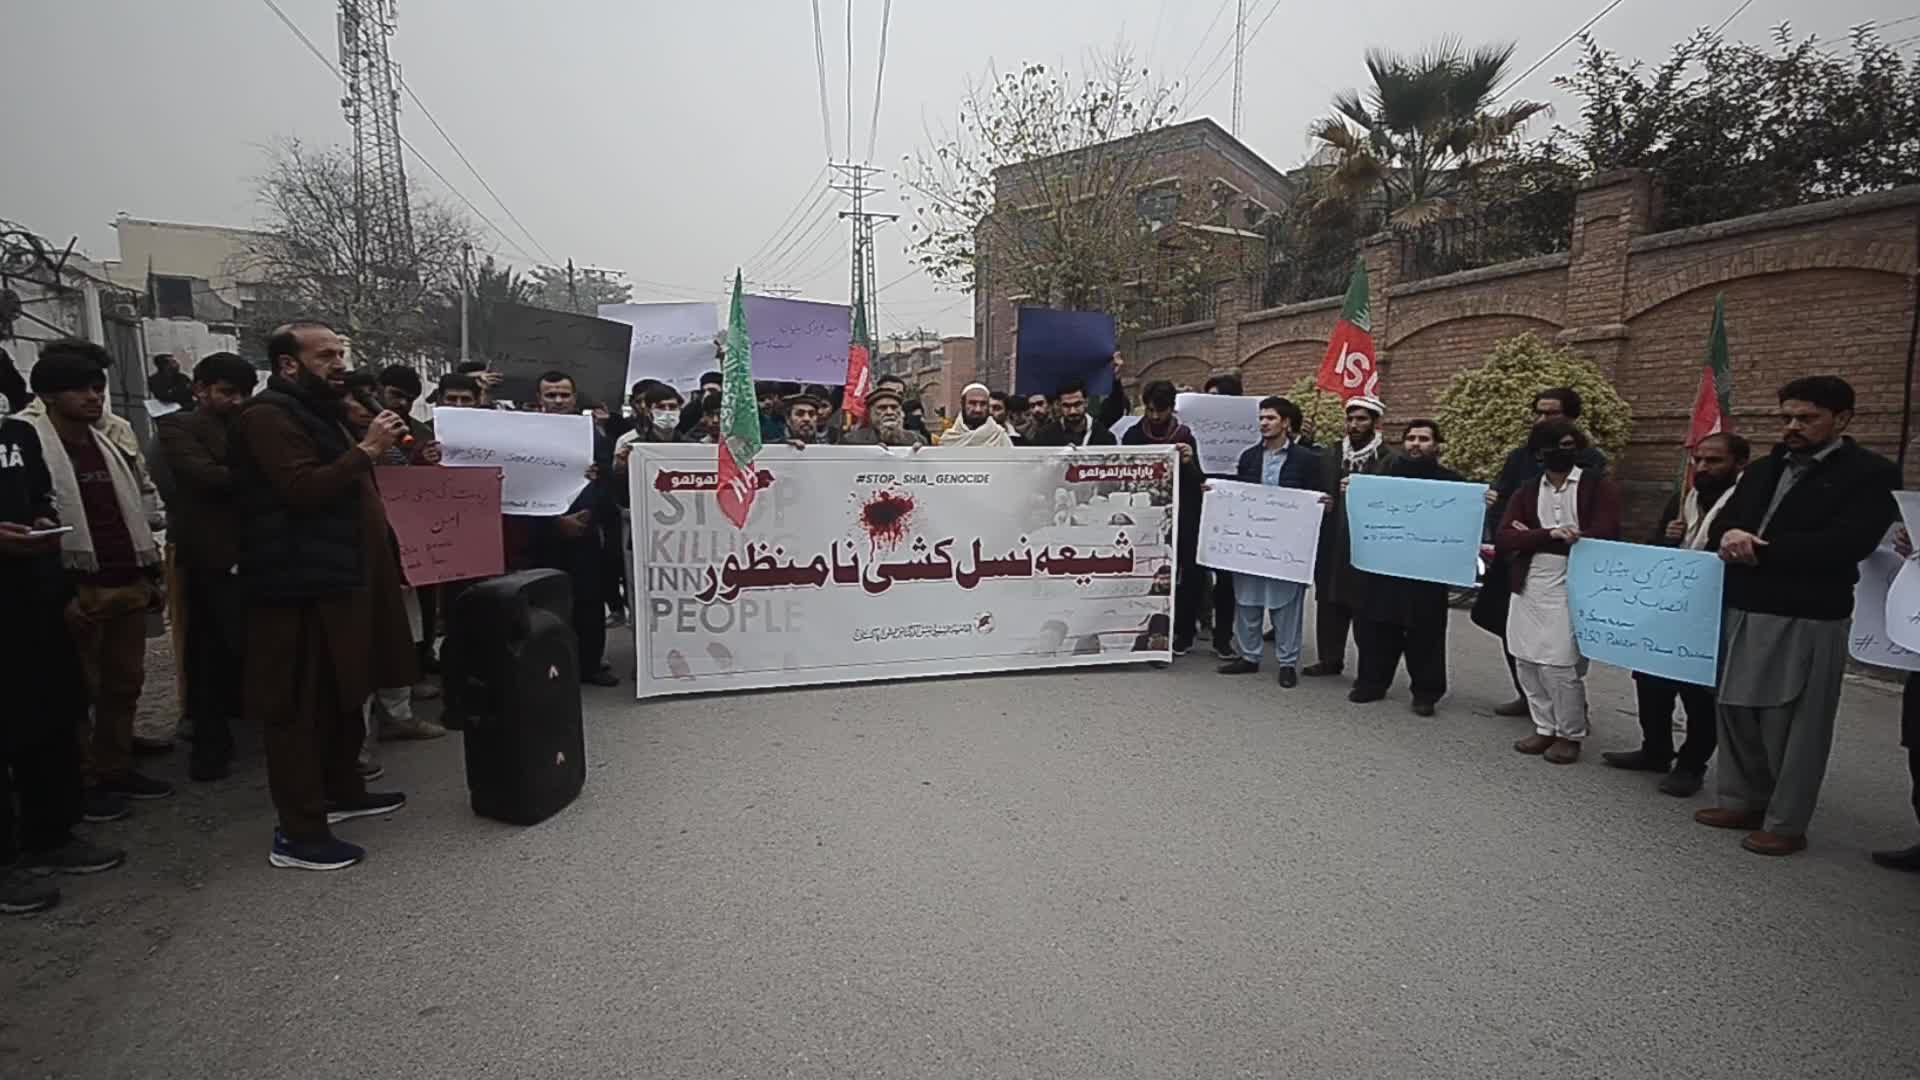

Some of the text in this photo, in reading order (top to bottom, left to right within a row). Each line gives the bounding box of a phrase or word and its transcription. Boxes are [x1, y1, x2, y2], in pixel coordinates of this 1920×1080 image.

[653, 478, 801, 527] STP
[863, 535, 954, 595] کشی
[955, 536, 1033, 590] نسل
[1034, 530, 1135, 586] شیعہ
[649, 597, 803, 633] PEOPLE
